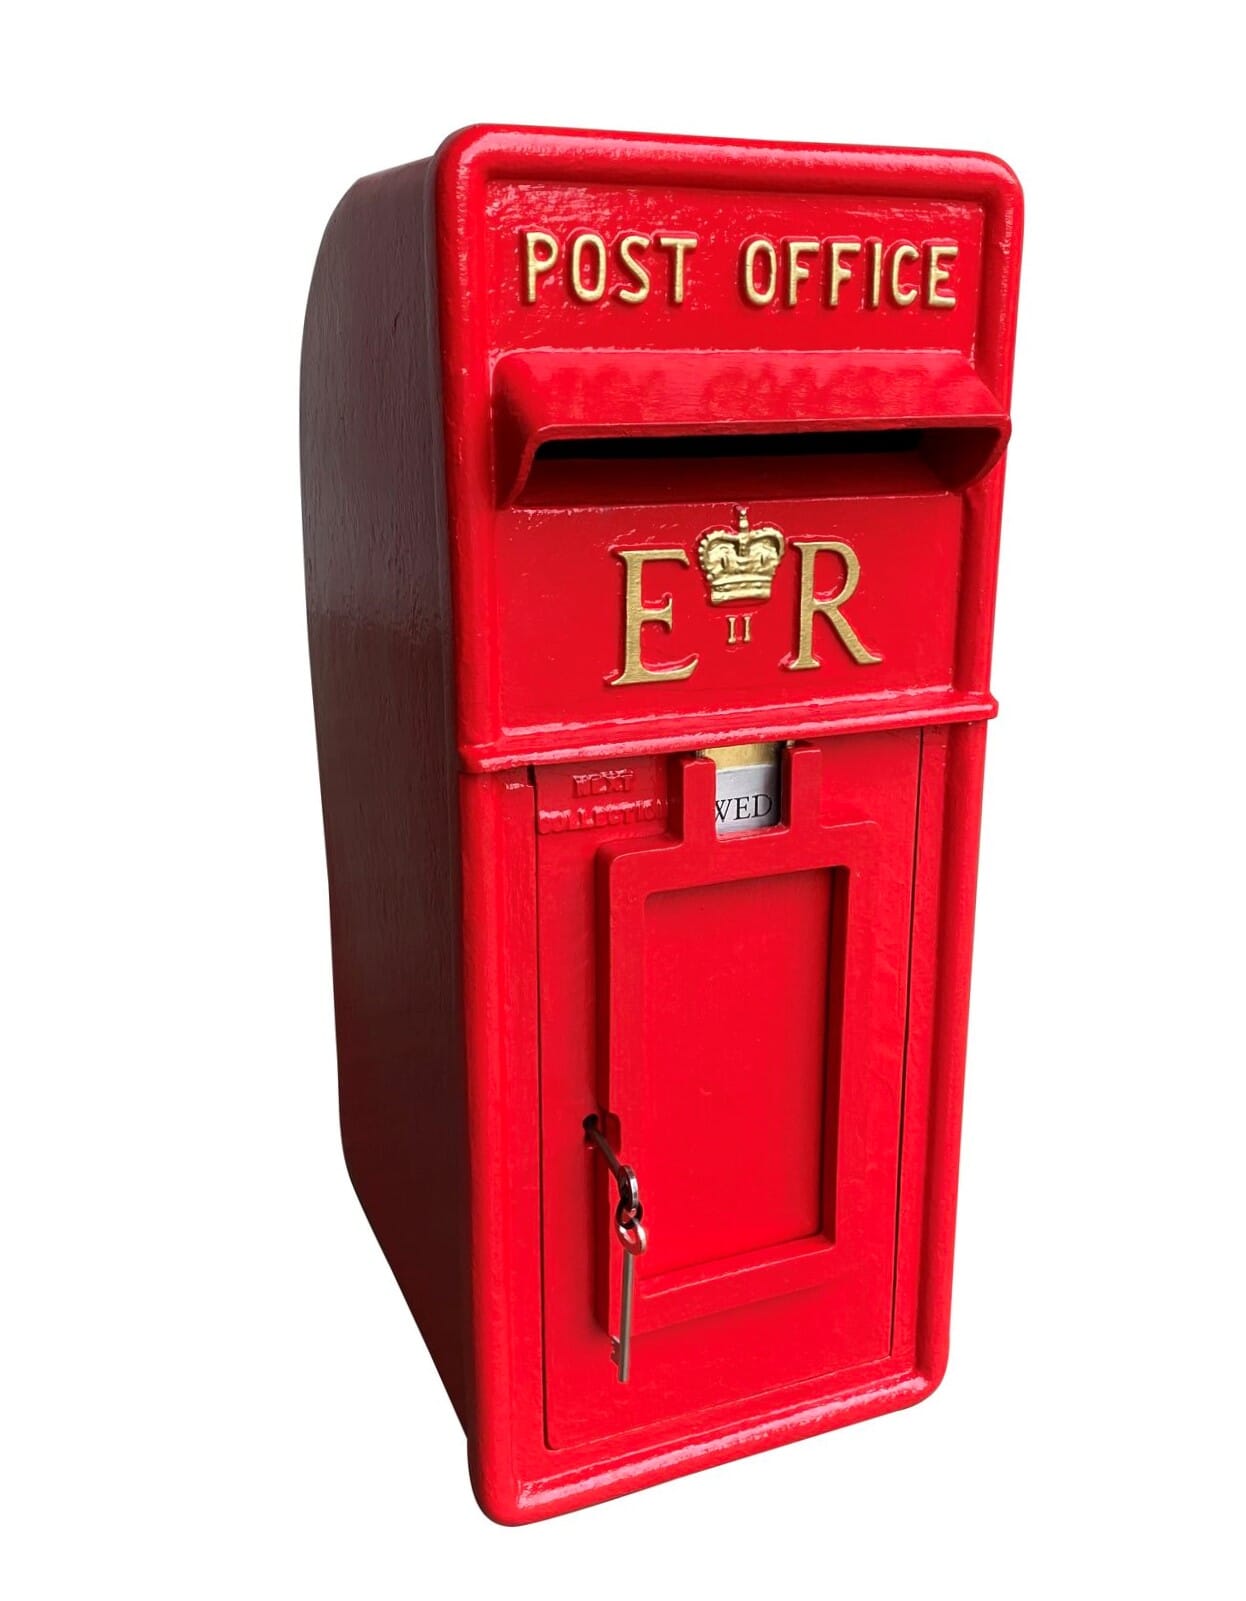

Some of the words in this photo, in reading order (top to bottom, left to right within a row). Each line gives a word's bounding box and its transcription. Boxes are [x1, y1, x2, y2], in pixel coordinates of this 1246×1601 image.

[524, 231, 698, 304] POST
[742, 239, 959, 308] OFFICE
[610, 548, 699, 685] E
[789, 541, 883, 671] R
[726, 615, 752, 644] II
[572, 769, 634, 797] NEXT
[715, 793, 773, 823] WED
